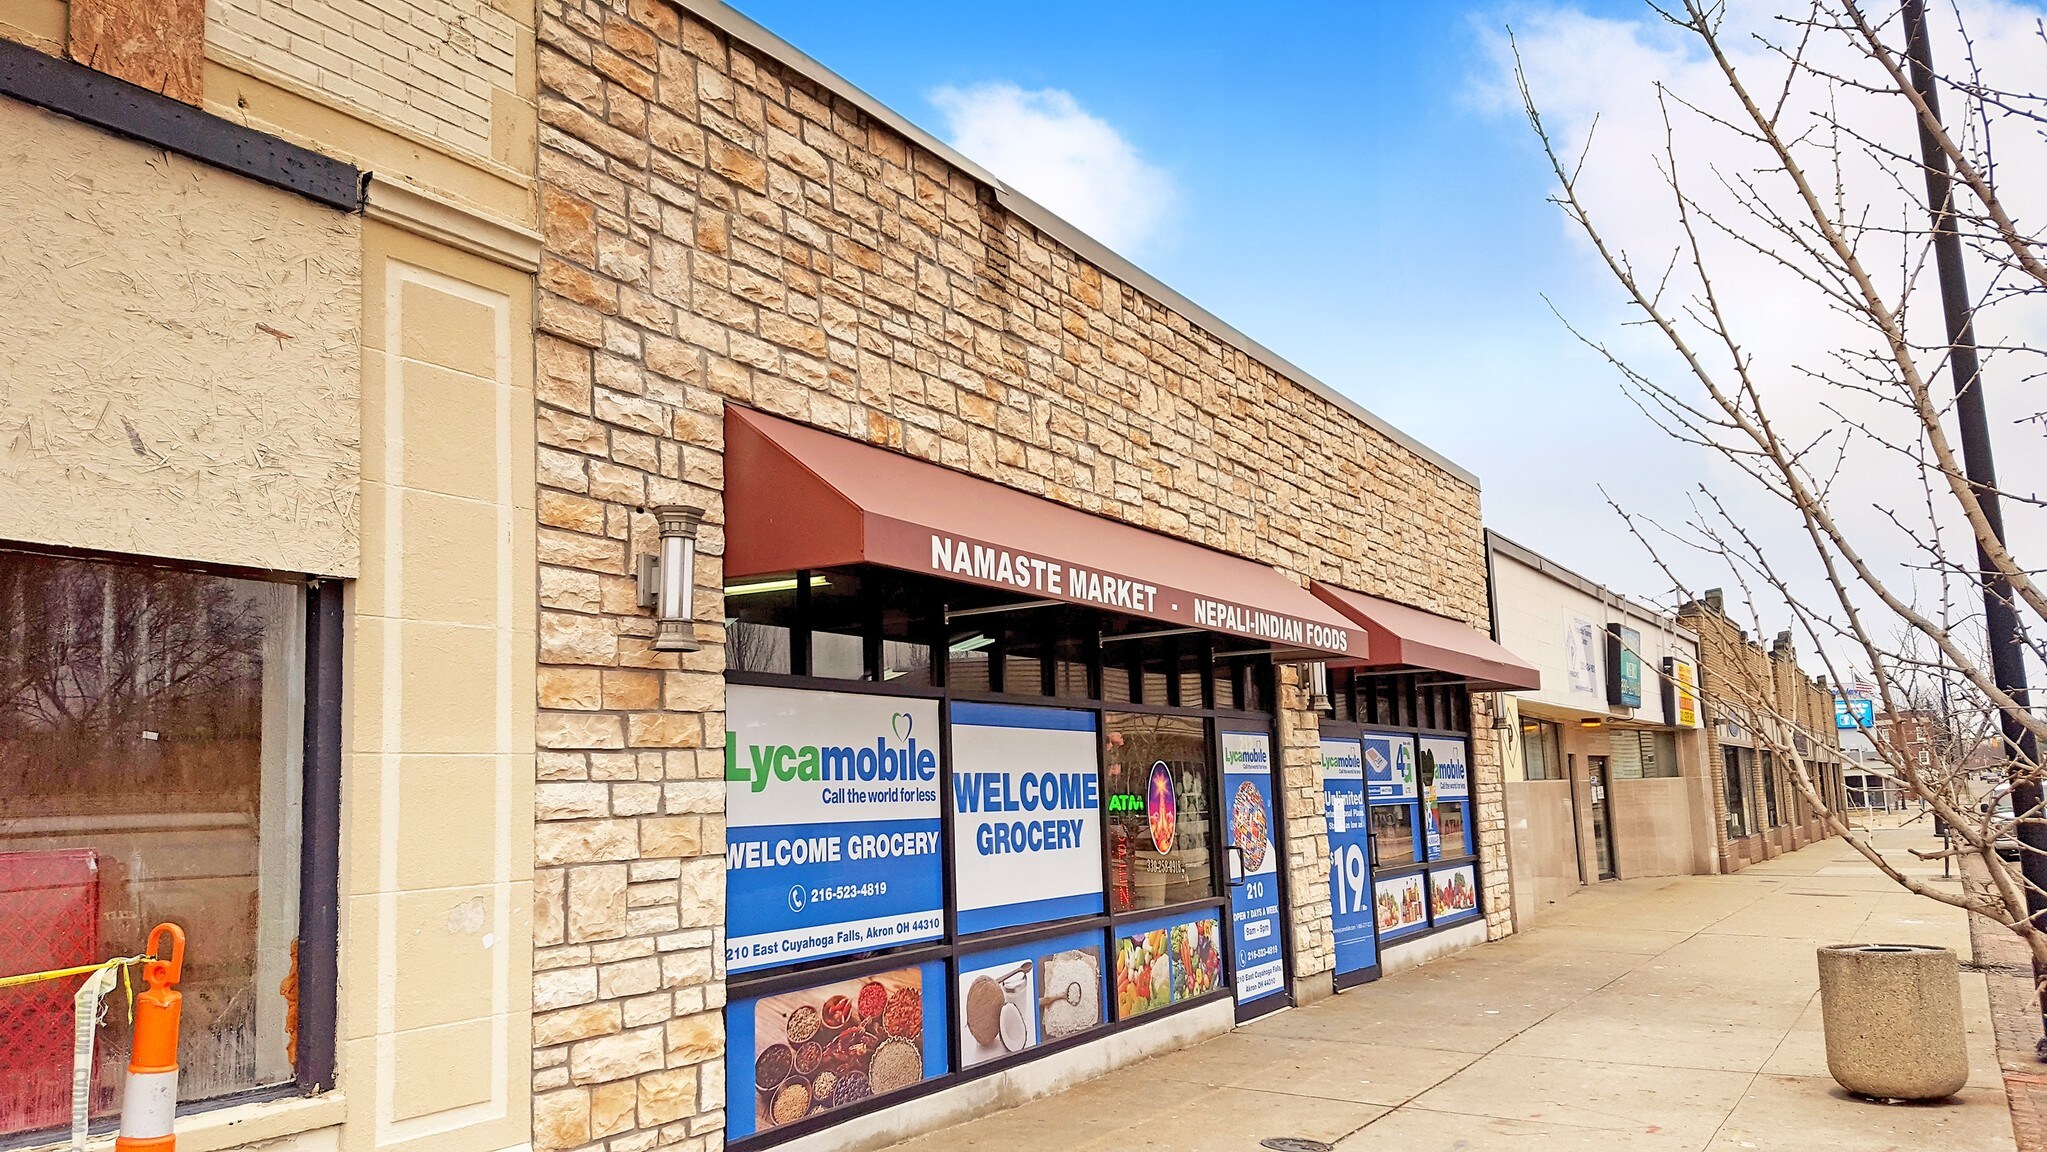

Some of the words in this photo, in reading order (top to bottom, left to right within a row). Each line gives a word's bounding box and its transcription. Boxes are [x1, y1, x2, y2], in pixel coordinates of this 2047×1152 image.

[931, 535, 1062, 595] NAMASTE
[1069, 568, 1157, 613] MARKET
[1194, 598, 1303, 644] NEPALI-INDIAN
[1306, 623, 1348, 653] FOODS
[726, 731, 936, 792] Lycamobile
[1225, 747, 1267, 765] Lycamobile
[1321, 753, 1361, 770] Lycamobile
[1396, 744, 1412, 783] 4G
[1434, 759, 1465, 780] amobile
[822, 788, 845, 804] Call
[847, 788, 867, 804] the
[868, 788, 899, 803] world
[900, 787, 915, 802] for
[916, 787, 936, 802] less
[953, 772, 1099, 813] WELCOME
[1108, 793, 1144, 812] ATM
[976, 819, 1084, 856] GROCERY
[726, 837, 841, 869] WELCOME
[848, 831, 939, 860] GROCERY
[811, 882, 887, 904] 216-523-4819
[1246, 881, 1264, 900] 210
[1233, 910, 1247, 922] OPEN
[1247, 910, 1250, 919] 7
[1251, 908, 1262, 919] DAYS
[1262, 907, 1266, 917] A
[727, 946, 749, 961] 210
[753, 942, 778, 957] East
[782, 935, 834, 952] Cuyahoga
[837, 929, 863, 943] Falls,
[866, 926, 894, 939] Akron
[896, 921, 910, 934] OH
[912, 918, 940, 932] 44310
[1246, 926, 1256, 936] 9am
[1260, 924, 1269, 935] 9pm
